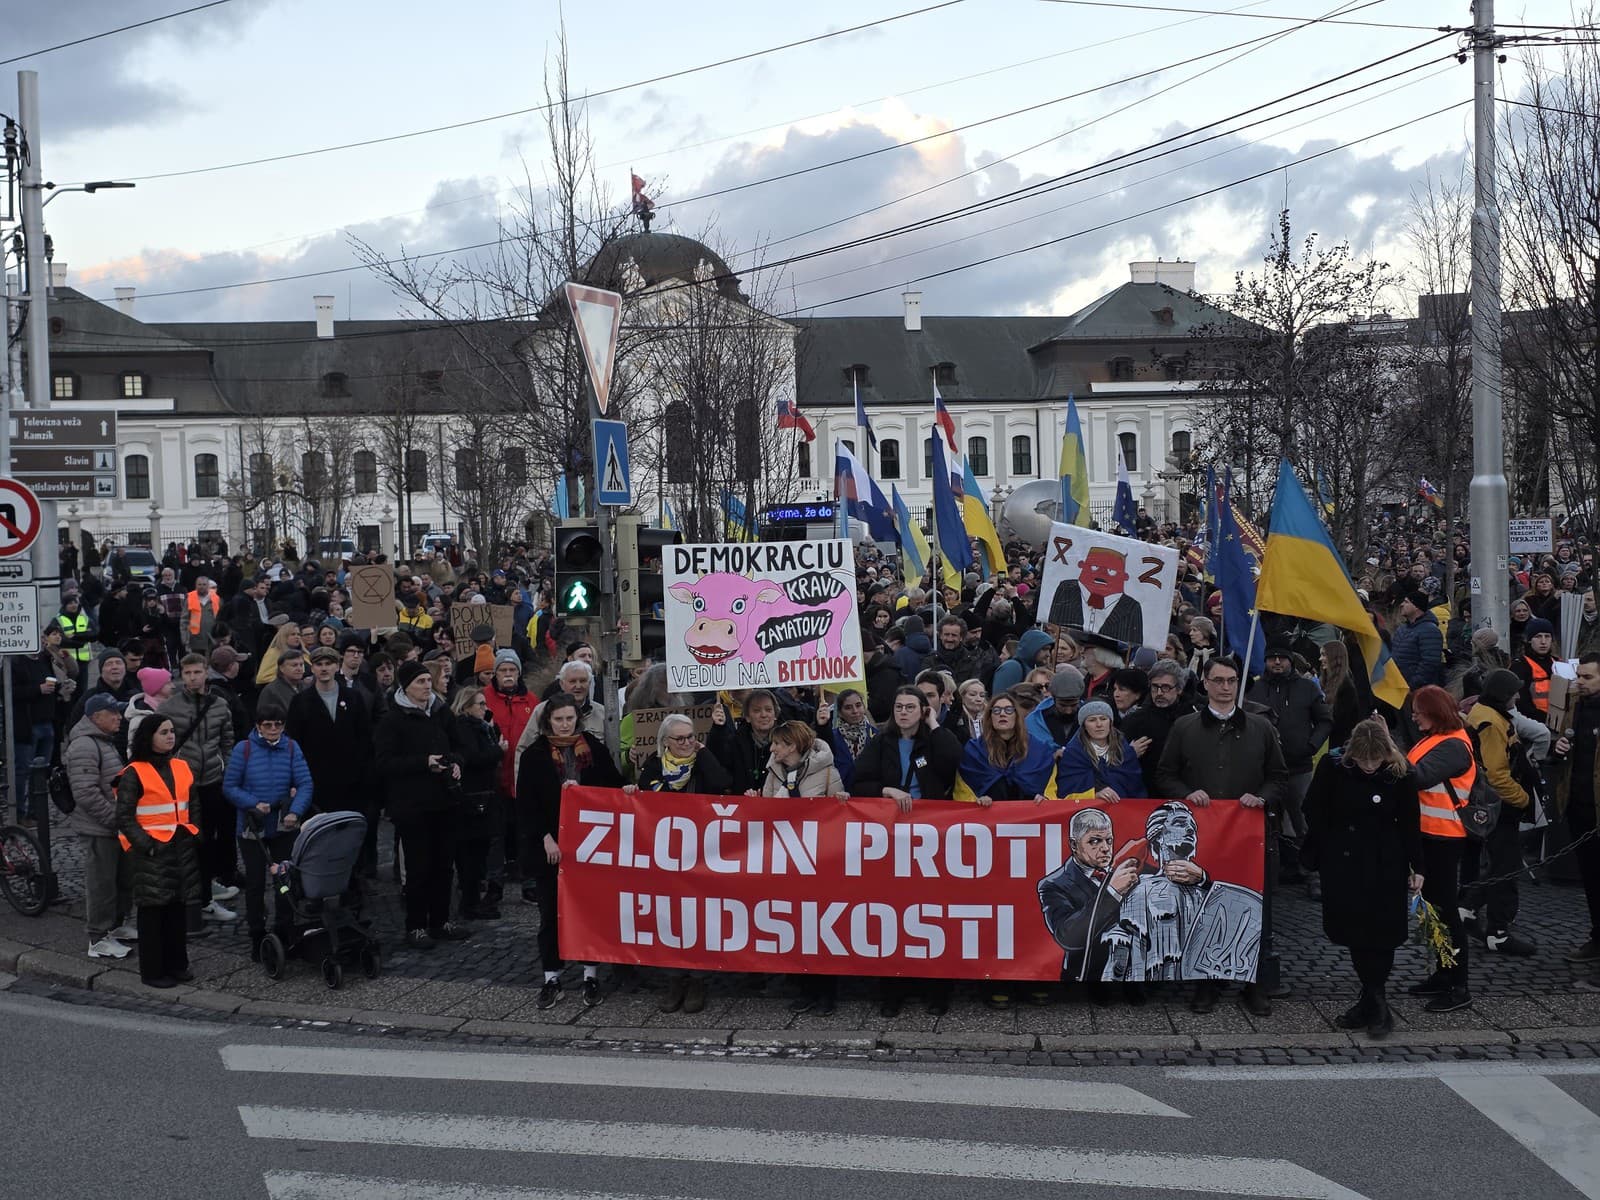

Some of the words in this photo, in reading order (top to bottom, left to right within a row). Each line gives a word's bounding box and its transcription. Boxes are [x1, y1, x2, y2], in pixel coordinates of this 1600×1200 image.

[23, 430, 54, 440] Kamzík
[63, 417, 82, 426] veža
[28, 481, 70, 494] atislavský
[71, 481, 90, 491] hrad
[818, 506, 832, 517] do
[674, 541, 843, 575] DEMOKRACIU
[786, 575, 842, 601] KRAVU
[756, 612, 832, 649] ZAMATOVÚ
[738, 661, 771, 685] NA
[778, 654, 857, 683] BITÚNOK
[575, 803, 819, 875] ZLOČIN
[845, 822, 1063, 879] PROTI
[618, 891, 1015, 960] ĽUDSKOSTI
